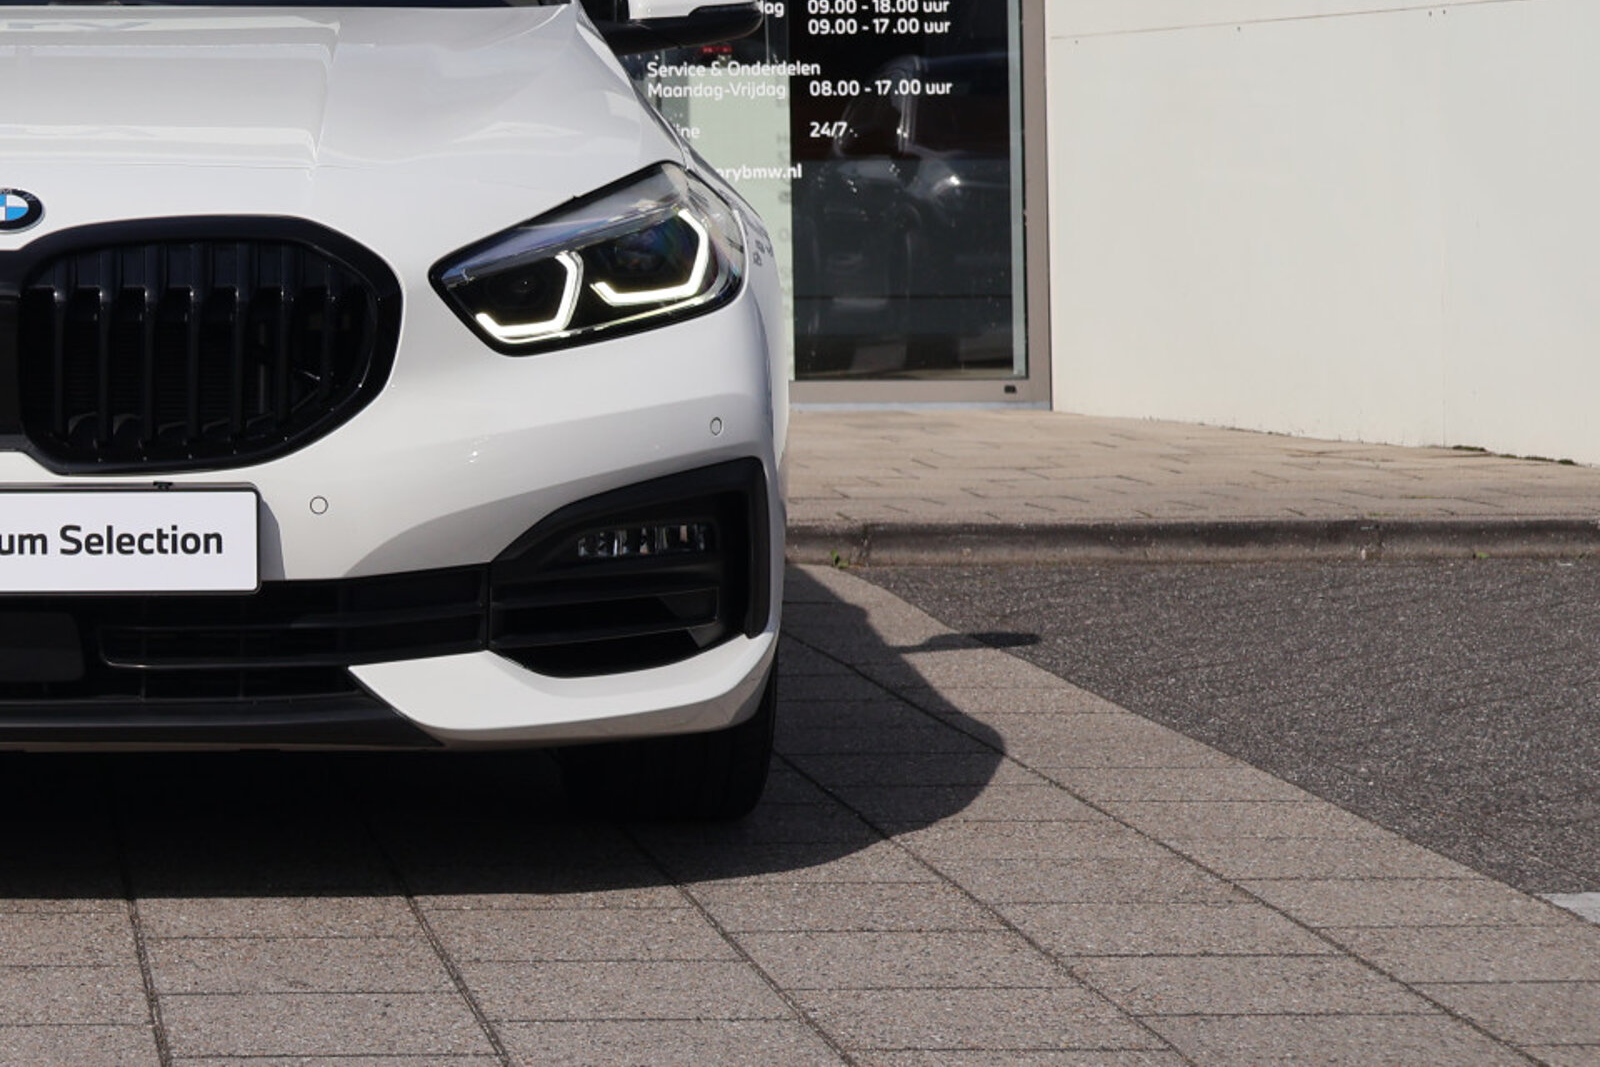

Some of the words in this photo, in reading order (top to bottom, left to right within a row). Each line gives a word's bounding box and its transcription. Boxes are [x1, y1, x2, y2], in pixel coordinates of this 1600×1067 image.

[808, 0, 857, 14] 09.00
[923, 0, 950, 13] uur
[808, 19, 857, 34] 09.00
[924, 20, 951, 34] uur
[647, 62, 705, 77] Service
[710, 62, 722, 77] &
[727, 61, 821, 77] Onderdelen
[647, 81, 787, 101] Maandag-Vrijdag
[809, 81, 859, 96] 08.00
[926, 81, 953, 95] uur
[810, 122, 847, 138] 24/7
[60, 525, 223, 554] Selection
